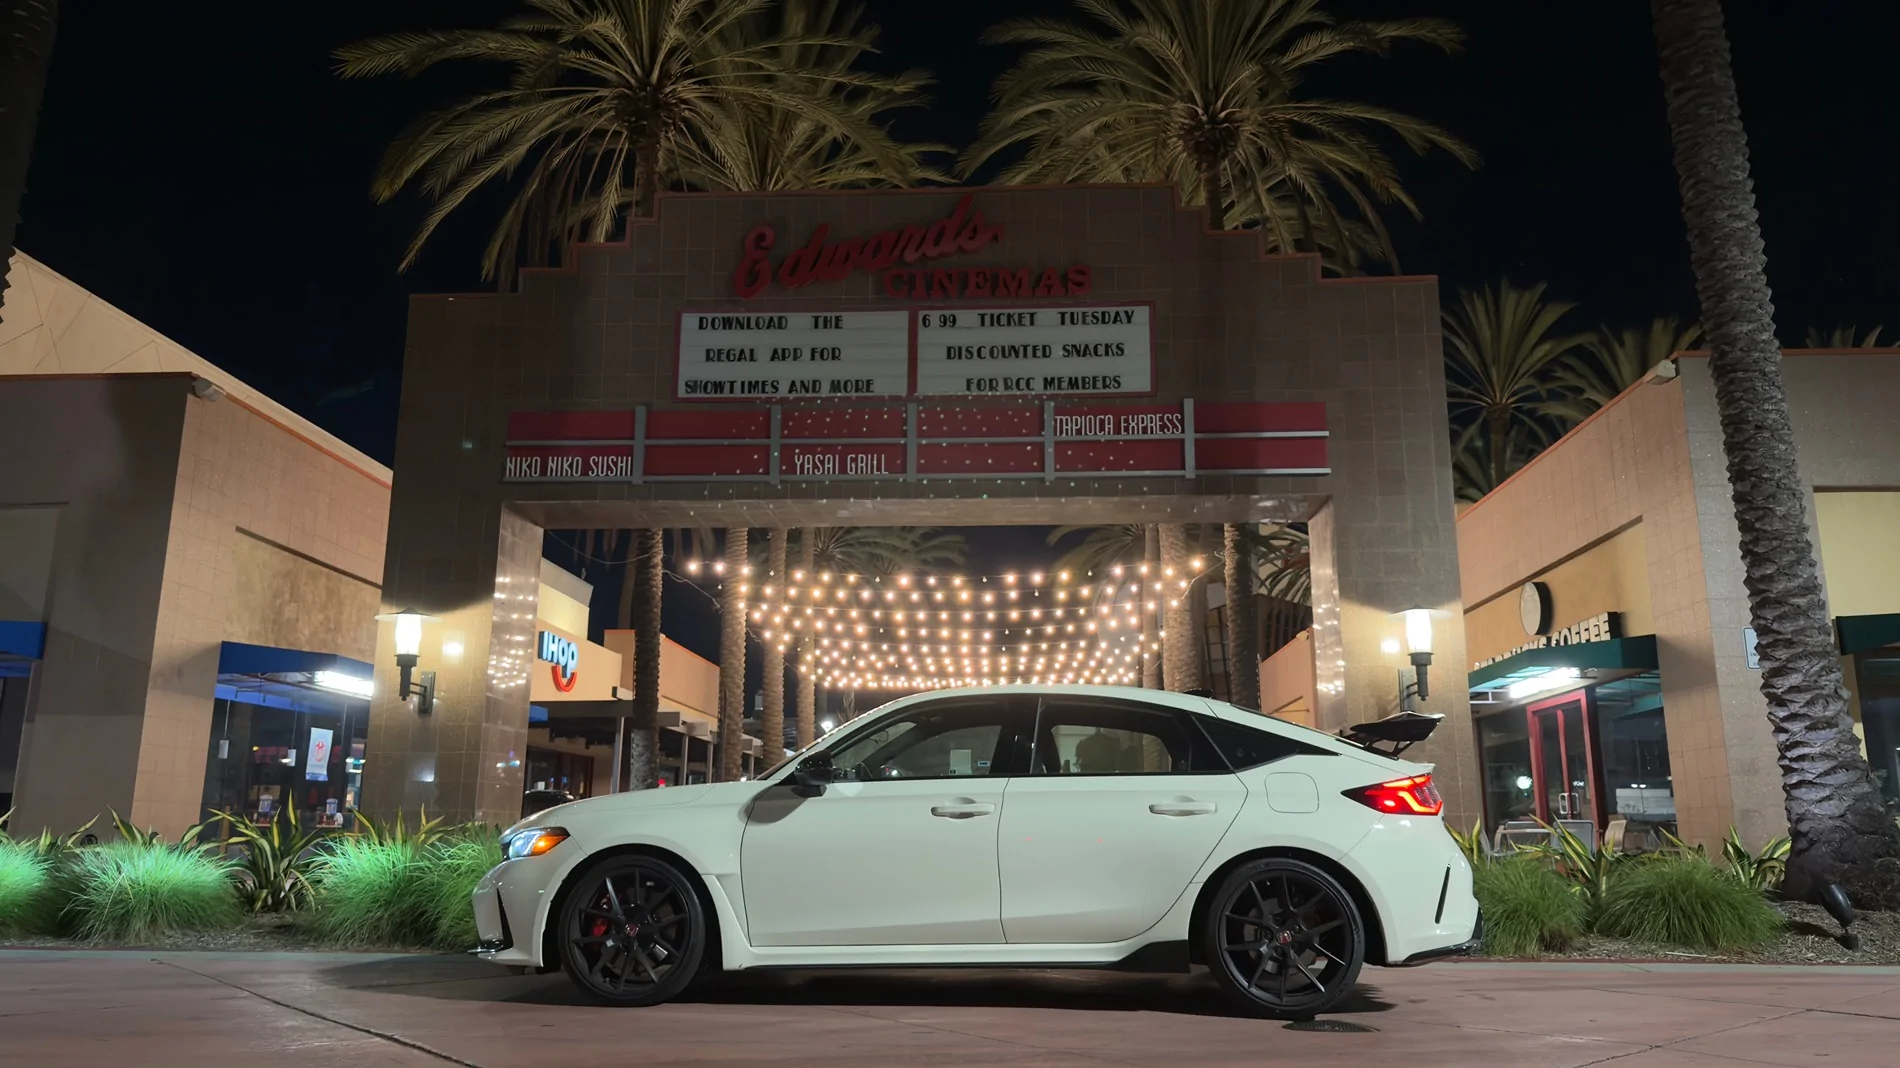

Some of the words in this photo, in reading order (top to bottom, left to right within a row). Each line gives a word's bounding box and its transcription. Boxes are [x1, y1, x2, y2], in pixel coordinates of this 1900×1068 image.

[733, 193, 1005, 299] Edwards
[883, 263, 1093, 299] CINEMAS
[698, 316, 788, 331] DOWNLOAD
[811, 315, 844, 330] THE
[977, 312, 1037, 327] TICKET
[1057, 310, 1135, 326] TUESDAY
[705, 348, 757, 362] REGAL
[769, 347, 803, 362] APP
[810, 347, 842, 362] FOR
[946, 344, 1052, 360] DISCOUNTED
[1062, 342, 1125, 358] SNACKS
[685, 379, 779, 394] SHOWTIMES
[788, 379, 822, 394] AND
[829, 379, 875, 393] MORE
[965, 377, 999, 392] FOR
[1003, 376, 1035, 392] RCC
[1043, 375, 1122, 391] MEMBERS
[1054, 414, 1114, 437] TAPIOCA
[1120, 413, 1182, 435] EXPRESS
[505, 456, 541, 478] NIKO
[547, 456, 582, 478] NIKO
[588, 455, 633, 477] SUSHI
[794, 454, 839, 476] YASAI
[846, 453, 889, 475] GRILL
[1550, 611, 1611, 648] COFFEE
